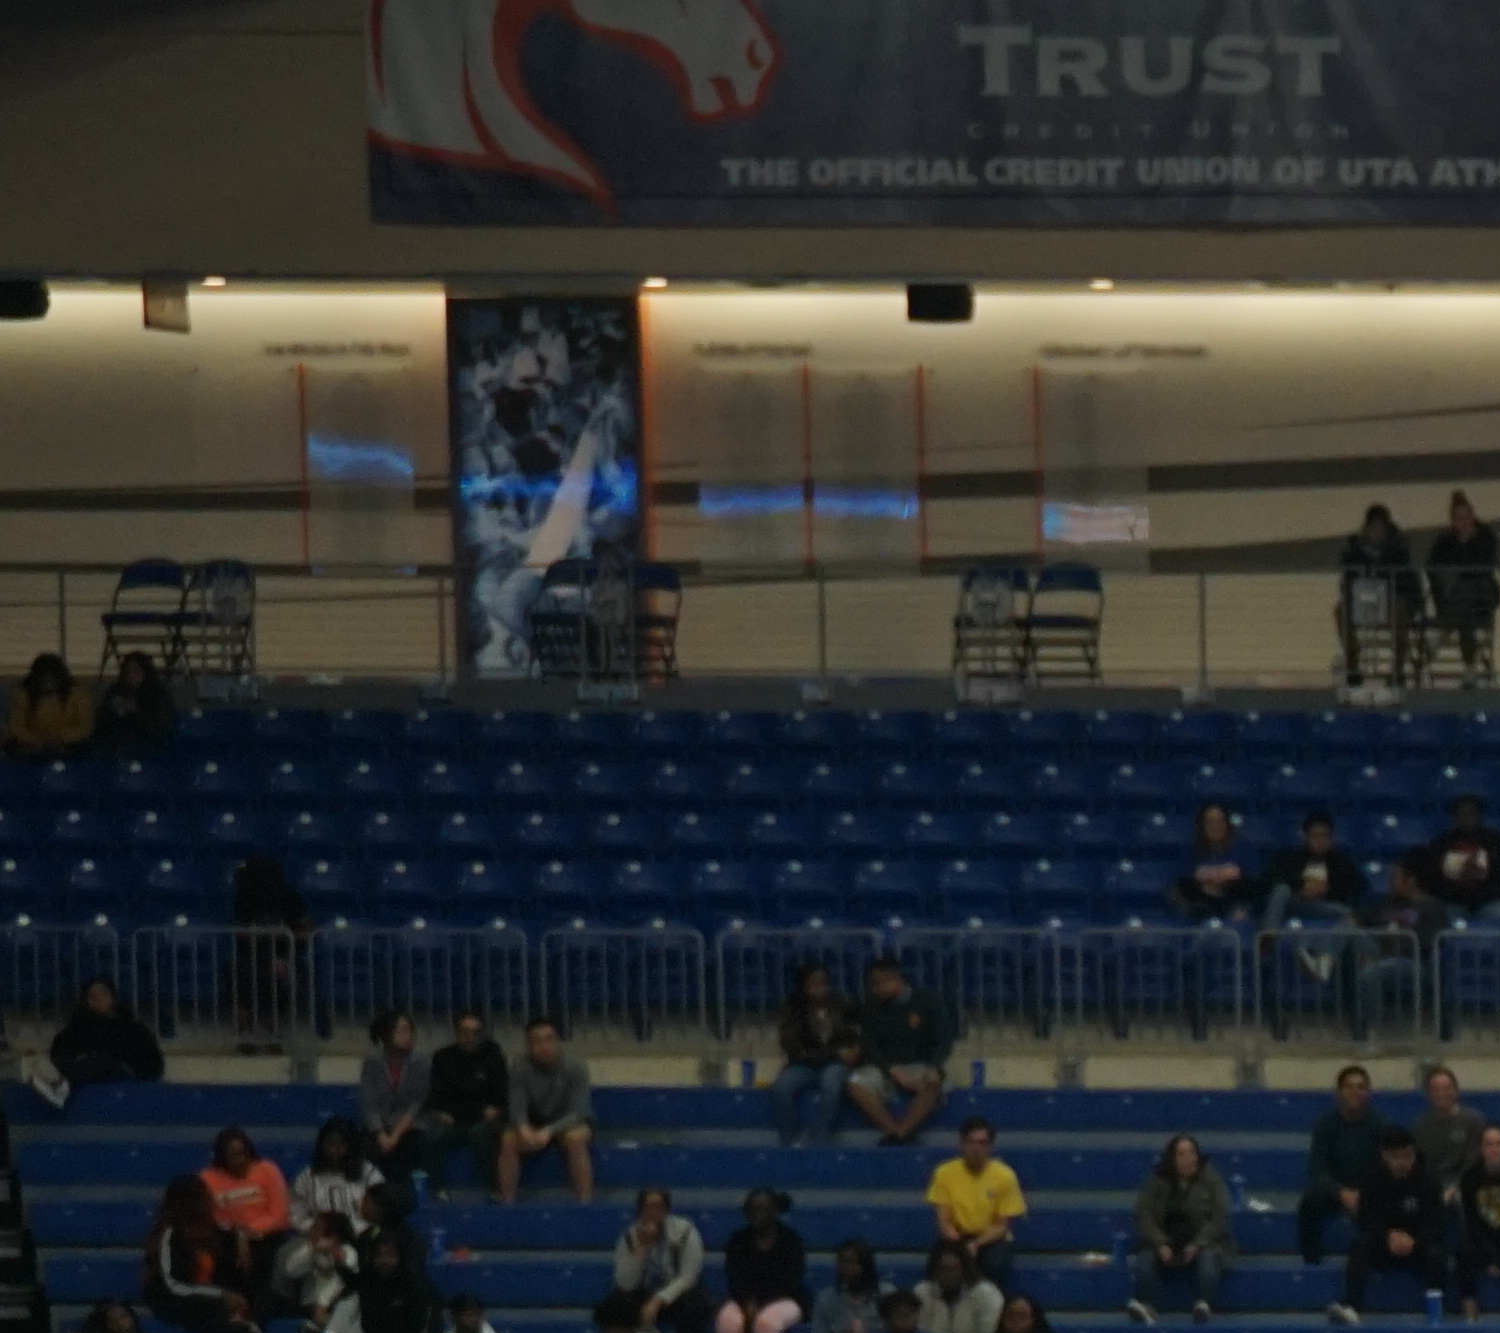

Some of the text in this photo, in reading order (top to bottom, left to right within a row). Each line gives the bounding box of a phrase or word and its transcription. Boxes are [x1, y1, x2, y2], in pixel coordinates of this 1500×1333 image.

[957, 23, 1342, 98] TRUST
[721, 157, 799, 187] THE
[809, 157, 977, 187] OFFICIAL
[985, 157, 1124, 187] CREDIT
[1135, 157, 1265, 187] UNION
[1275, 157, 1324, 187] OF
[1338, 157, 1418, 187] UTA
